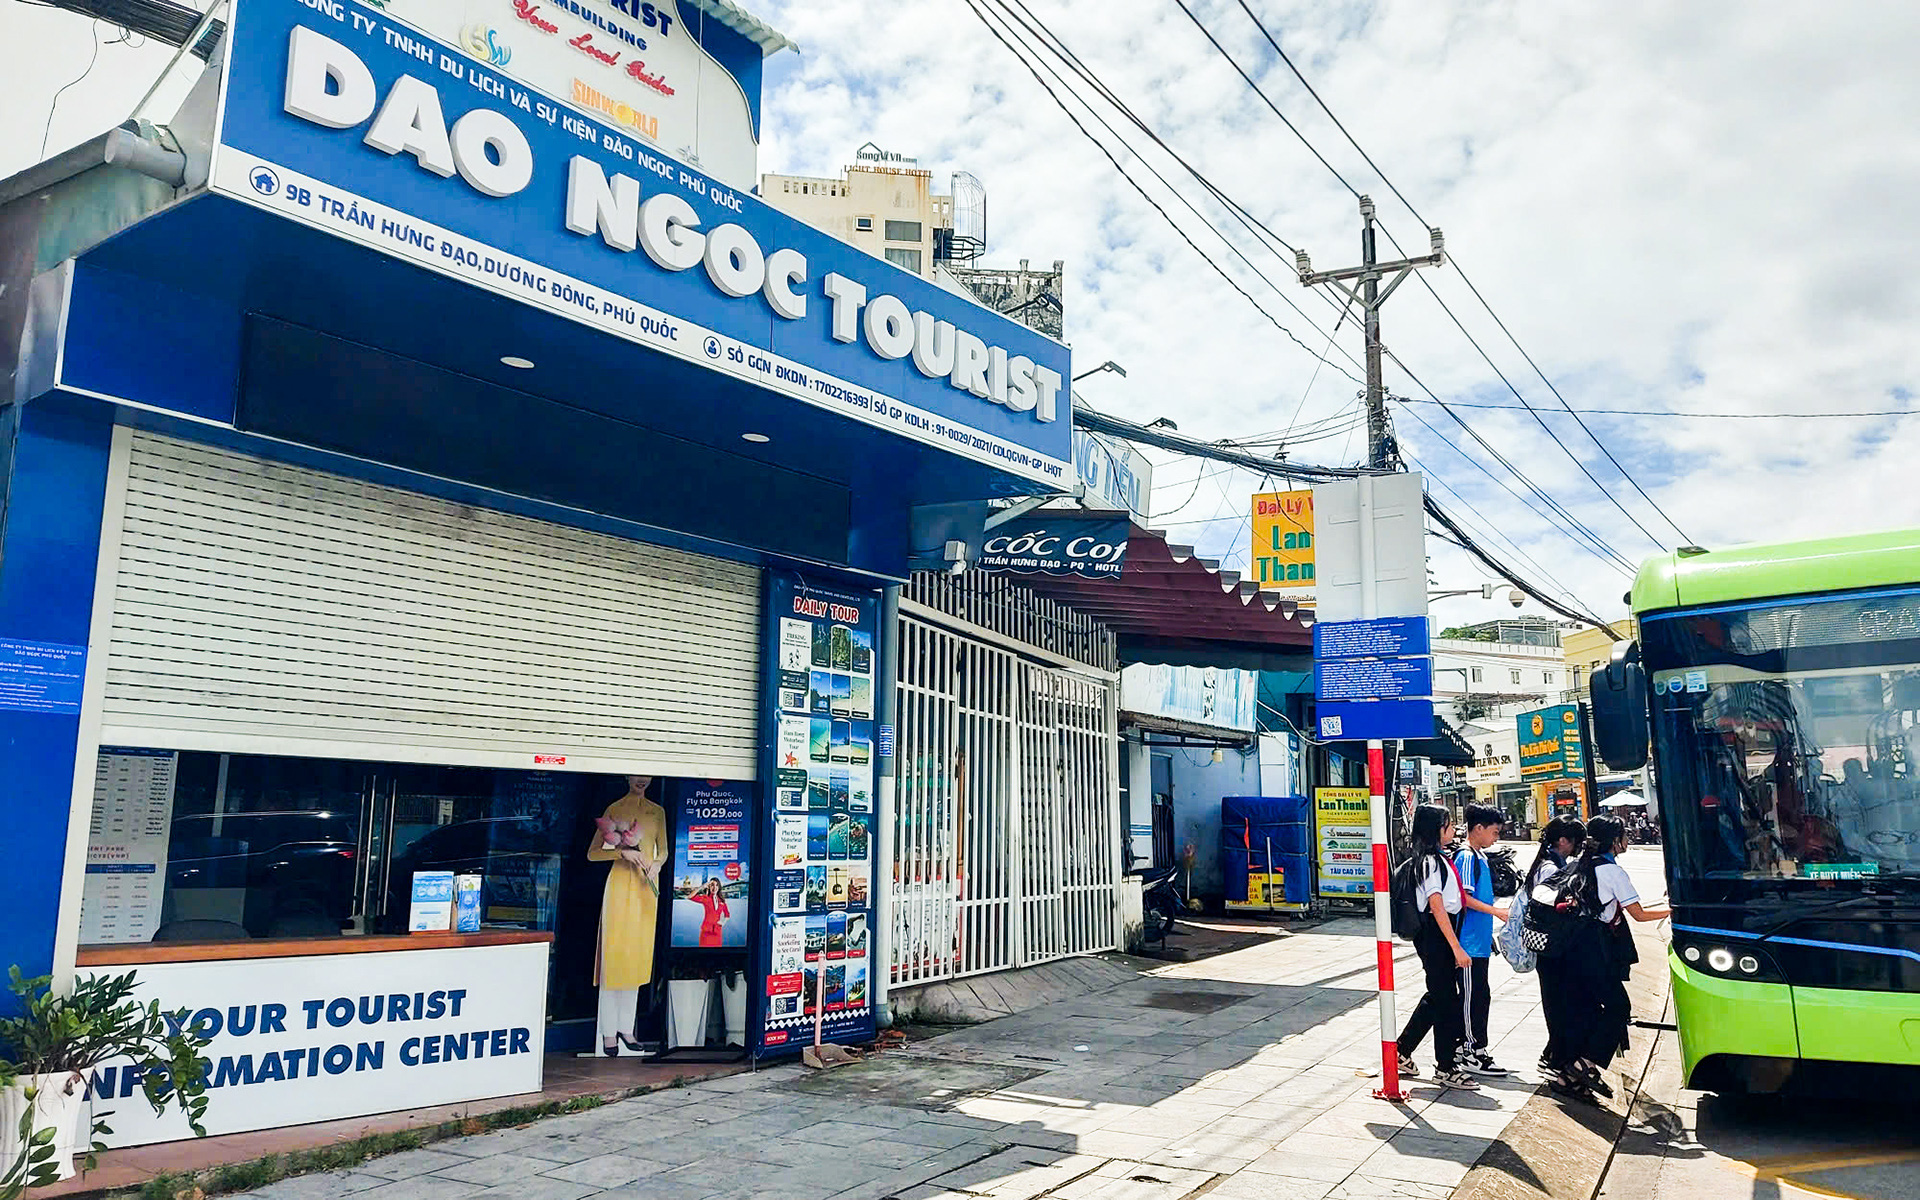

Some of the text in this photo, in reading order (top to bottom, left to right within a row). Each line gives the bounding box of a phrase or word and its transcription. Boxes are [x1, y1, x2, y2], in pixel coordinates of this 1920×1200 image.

[568, 33, 621, 67] Local
[350, 11, 377, 36] TY
[382, 26, 434, 65] TNHH
[440, 54, 463, 79] DU
[469, 68, 505, 100] LỊCH
[509, 88, 531, 113] VÀ
[536, 102, 557, 126] SỰ
[562, 115, 597, 144] KIỆN
[603, 134, 633, 160] ĐẢO
[638, 151, 674, 180] NGỌC
[680, 171, 706, 196] PHÚ
[844, 164, 934, 178] LIGHT HOUSE HOTEL
[283, 24, 1062, 423] DAO NGOC TOURIST
[286, 184, 311, 207] 9B
[381, 218, 435, 252] HƯNG
[551, 283, 599, 314] ĐÔNG,
[603, 301, 636, 325] PHÚ
[640, 316, 679, 341] QUỐC
[748, 355, 772, 374] GCN
[775, 364, 807, 387] ĐKDN
[814, 379, 869, 409] 1702216393
[889, 406, 902, 420] GP
[904, 412, 930, 432] KDLH
[1272, 524, 1312, 550] Lan
[793, 596, 860, 624] DAILY TOUR
[1768, 606, 1920, 648] 17 GRA
[686, 798, 698, 806] Fly
[709, 797, 743, 806] Bangkok
[696, 790, 711, 798] Phu
[162, 989, 468, 1039] YOUR TOURIST
[399, 1026, 531, 1067] CENTER
